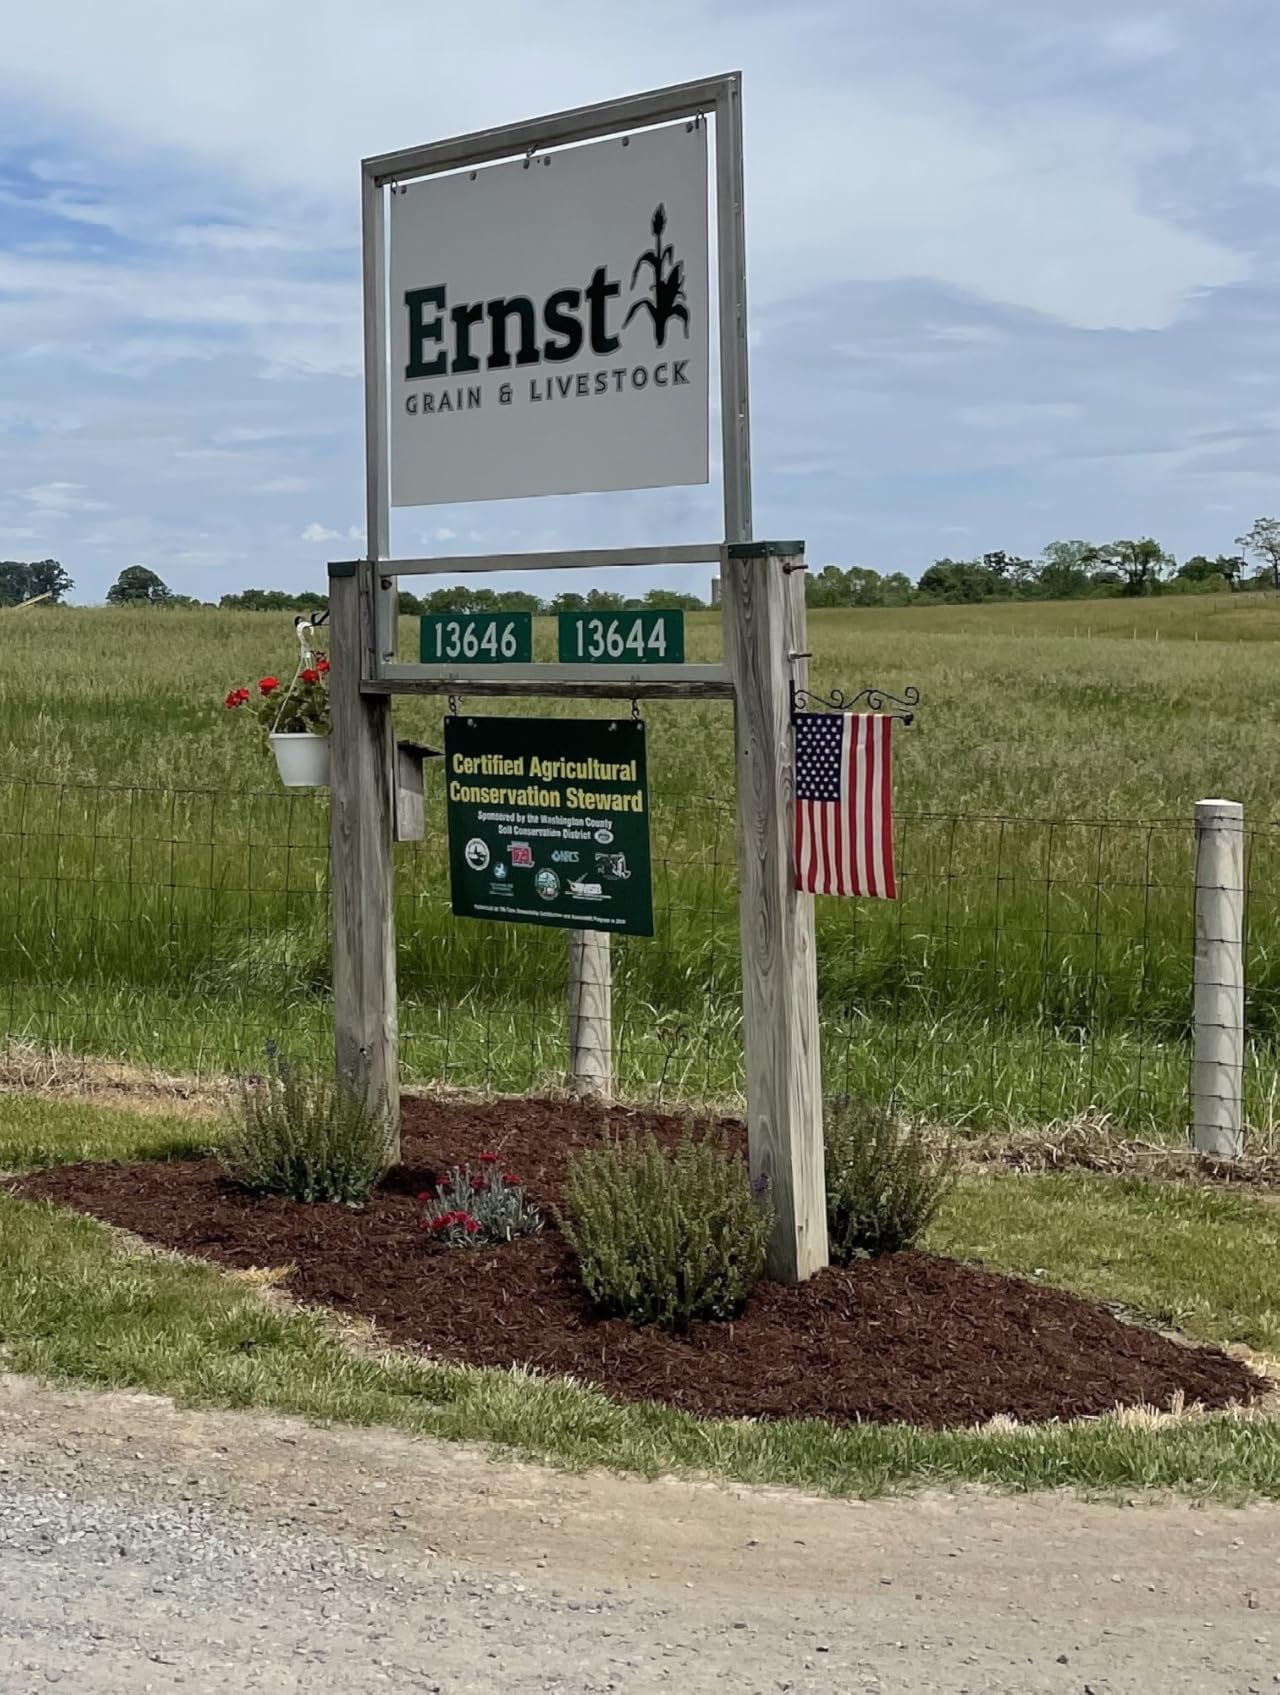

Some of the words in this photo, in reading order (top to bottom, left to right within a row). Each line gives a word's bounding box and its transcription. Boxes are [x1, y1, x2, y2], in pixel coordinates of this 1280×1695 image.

[404, 265, 621, 381] Ernst
[406, 385, 481, 415] GRAIN
[499, 383, 512, 405] &
[530, 359, 690, 401] LIVESTOCK
[435, 621, 517, 658] 13646
[575, 618, 667, 658] 13644
[452, 753, 524, 777] Certified
[529, 756, 637, 782] Agricultural
[450, 781, 560, 807] Conservation
[567, 787, 643, 812] Steward
[477, 810, 515, 822] Sponsored
[516, 812, 526, 824] by
[527, 813, 539, 824] the
[540, 814, 584, 828] Washington
[585, 817, 613, 830] County
[498, 824, 512, 835] Soil
[513, 826, 561, 837] Conservation
[562, 828, 591, 839] District
